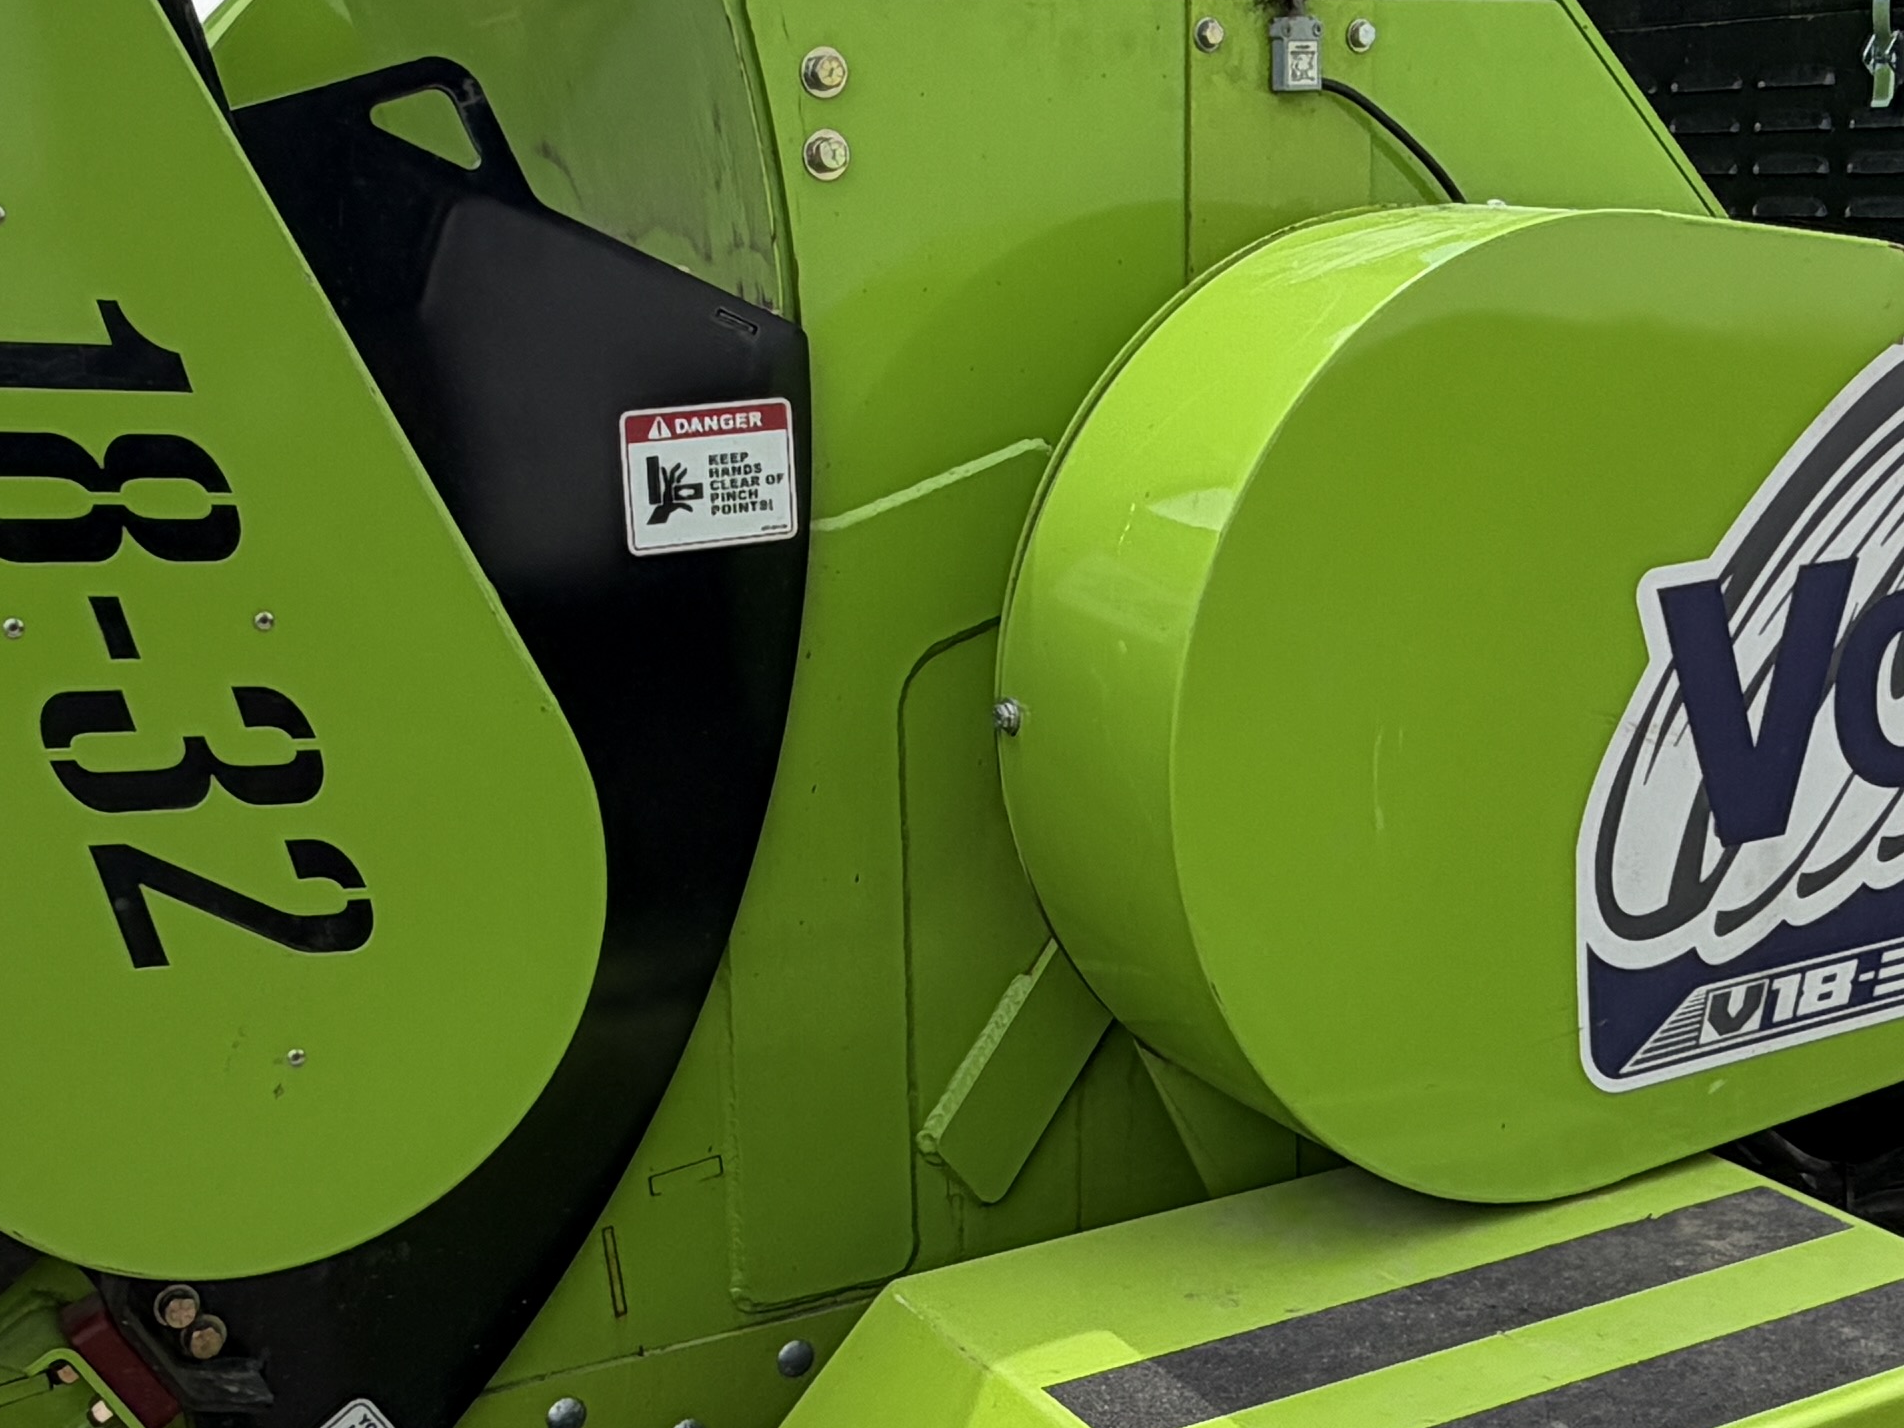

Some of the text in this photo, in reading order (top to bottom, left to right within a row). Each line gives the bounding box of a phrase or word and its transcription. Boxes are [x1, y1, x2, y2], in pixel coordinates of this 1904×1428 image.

[674, 411, 762, 434] DANGER
[708, 452, 749, 466] KEEP
[708, 463, 762, 479] HANDS
[709, 473, 784, 491] CLEAR OF
[710, 489, 759, 504] PINCH
